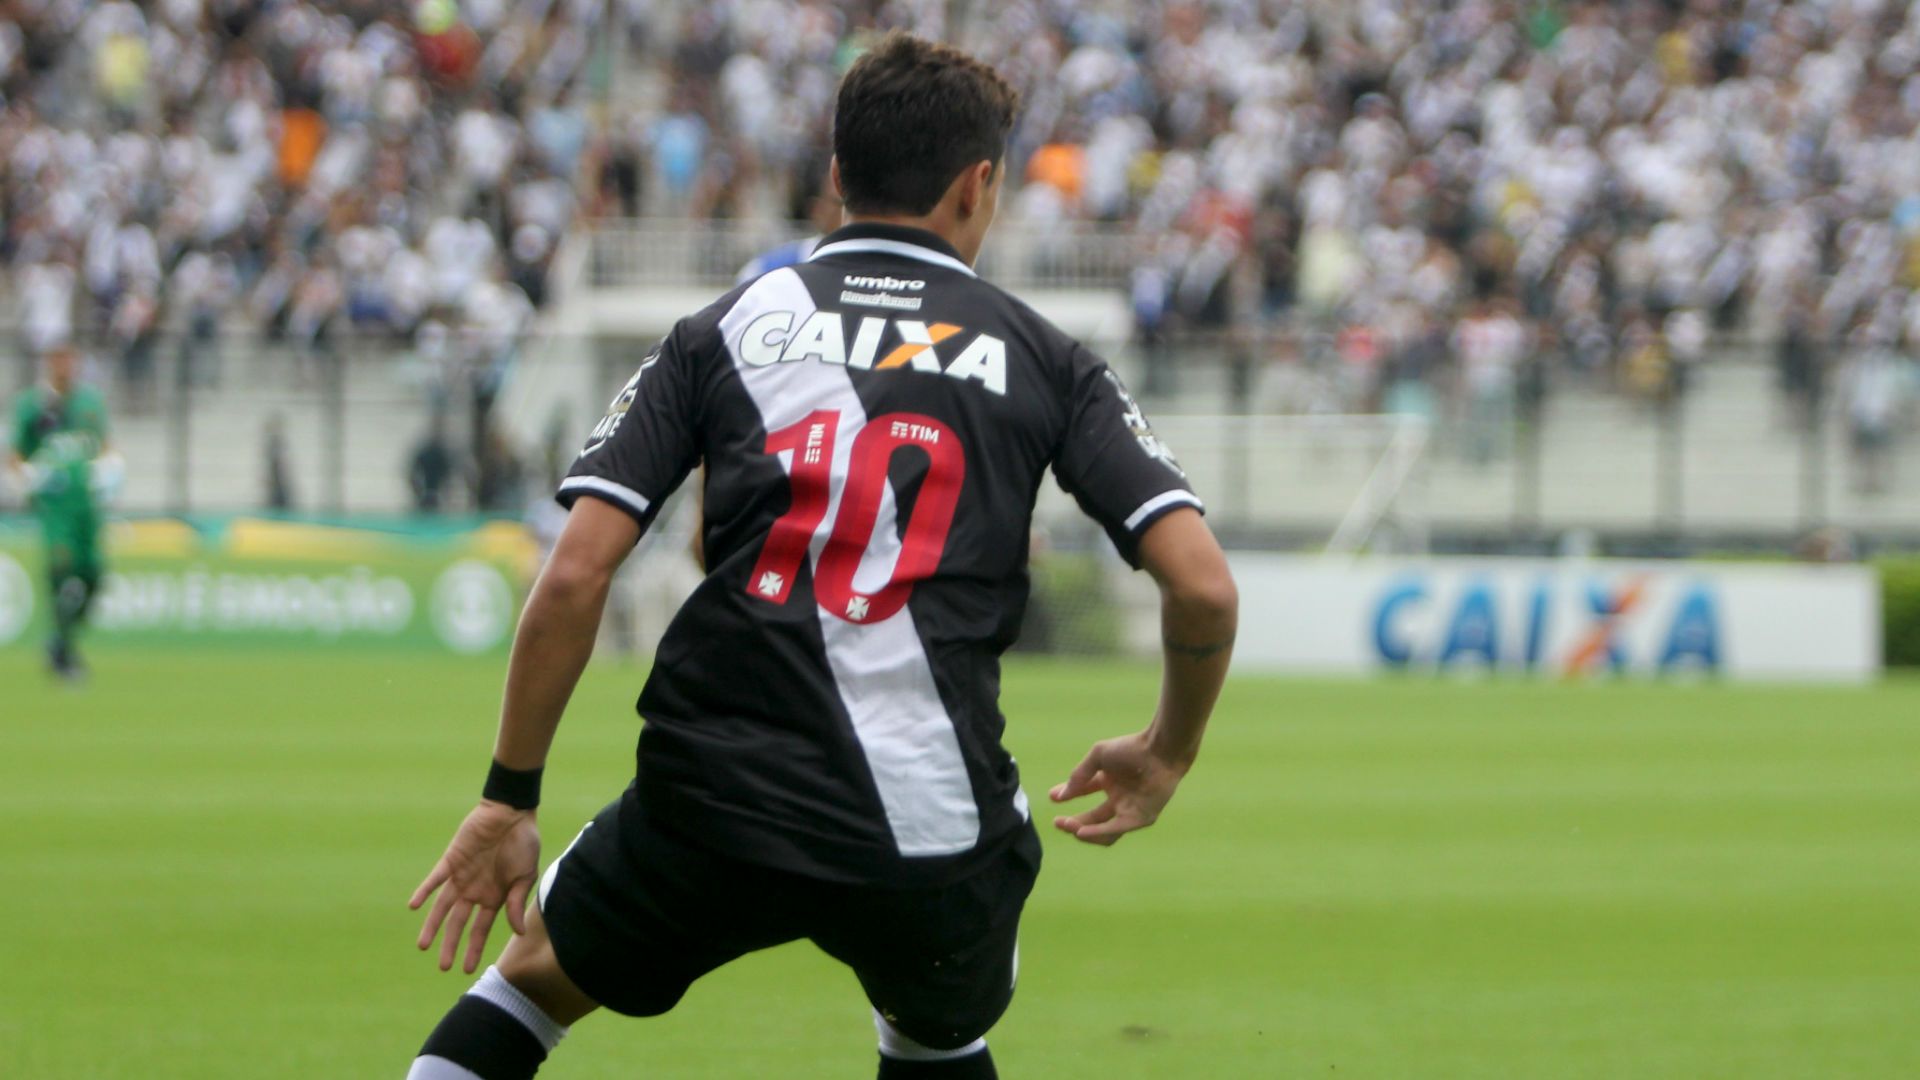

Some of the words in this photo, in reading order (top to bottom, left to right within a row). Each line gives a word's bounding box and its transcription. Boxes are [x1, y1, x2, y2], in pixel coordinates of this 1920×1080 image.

[844, 275, 926, 291] umbro
[739, 311, 1007, 396] CAIXA
[806, 423, 826, 448] TIM
[910, 424, 940, 444] TIM
[746, 409, 965, 625] 10
[95, 572, 174, 631] QUI
[215, 564, 414, 638] EMOÇÃO
[1373, 577, 1724, 676] CAIXA
